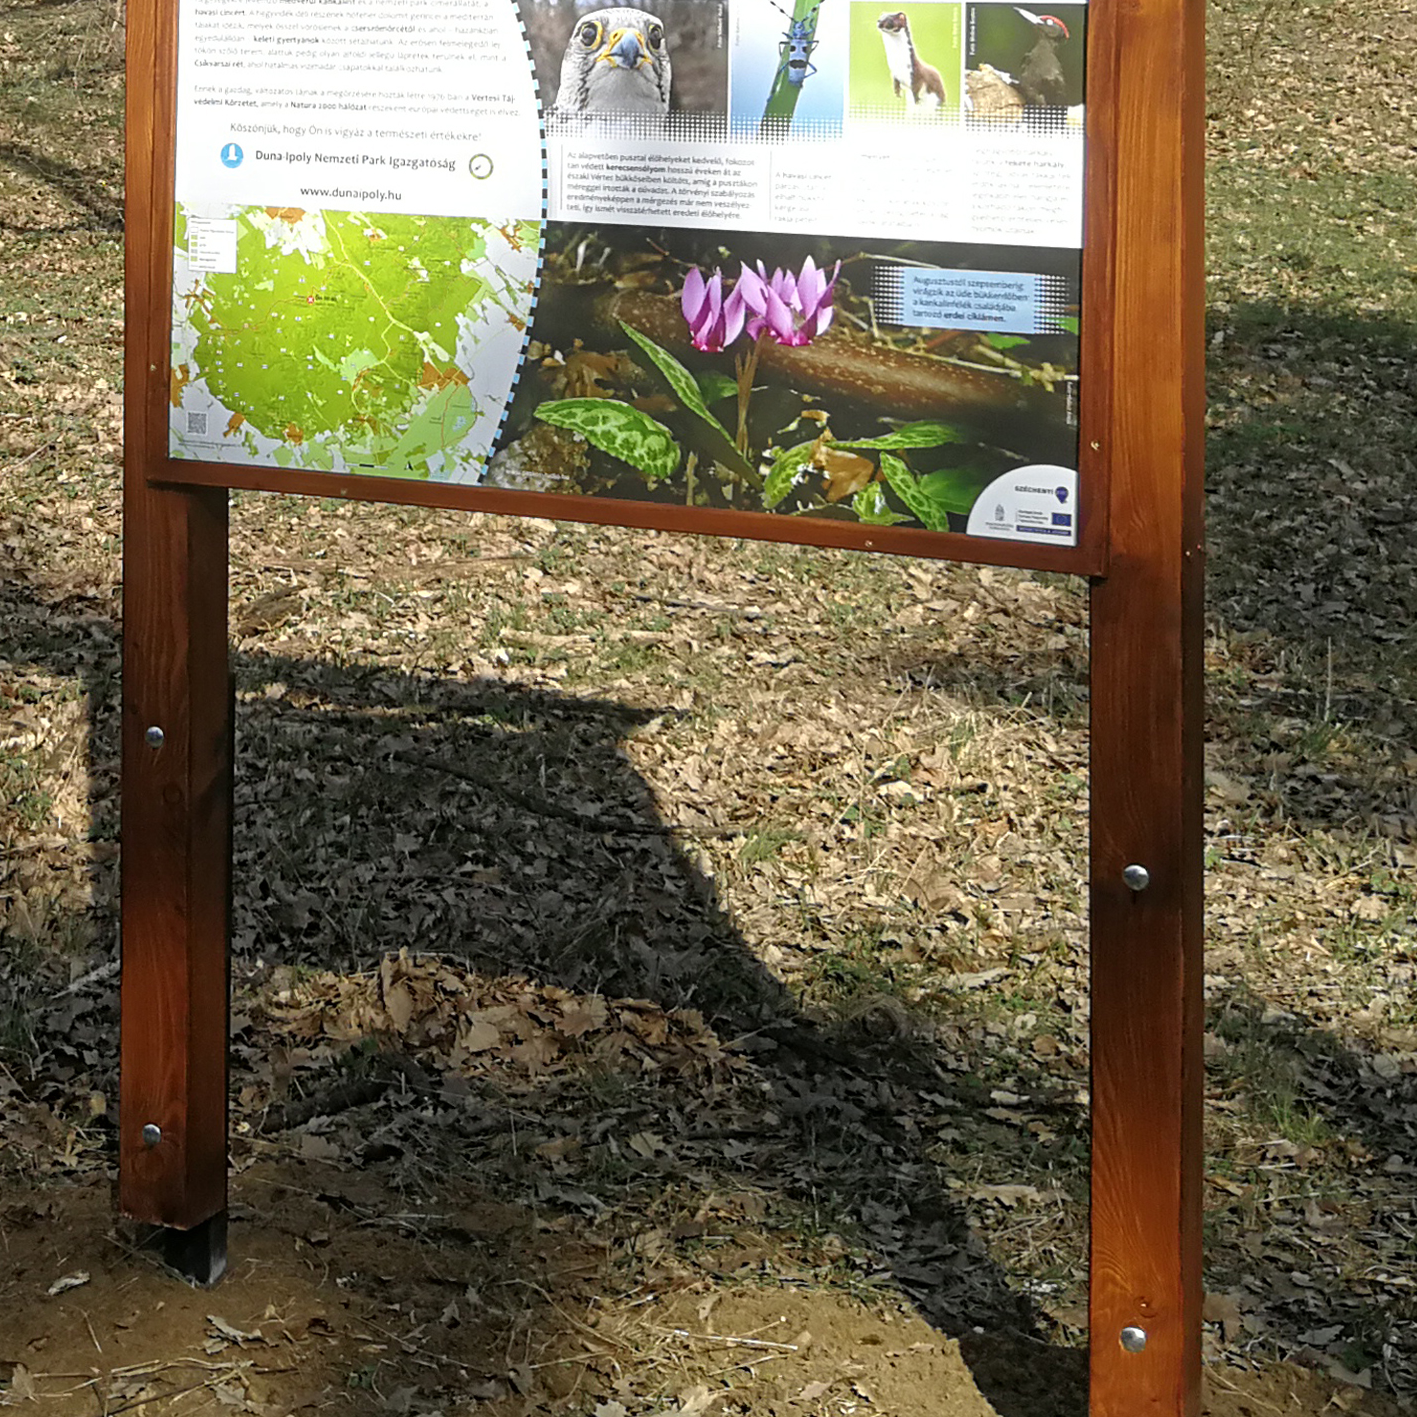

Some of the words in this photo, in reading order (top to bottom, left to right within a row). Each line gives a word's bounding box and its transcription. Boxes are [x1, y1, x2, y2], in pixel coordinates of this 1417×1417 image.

[230, 123, 280, 135] Köszönjük,
[282, 125, 306, 137] hogy
[308, 125, 322, 136] Ön
[324, 126, 332, 136] is
[334, 126, 364, 139] vigyáz
[366, 130, 372, 138] a
[375, 128, 427, 139] természeti
[429, 130, 481, 141] értékekre!
[255, 150, 311, 164] Duna-Ipoly
[314, 153, 358, 164] Nemzeti
[361, 155, 385, 166] Park
[389, 156, 455, 171] Igazgatóság
[300, 187, 401, 202] www.dunaipoly.hu
